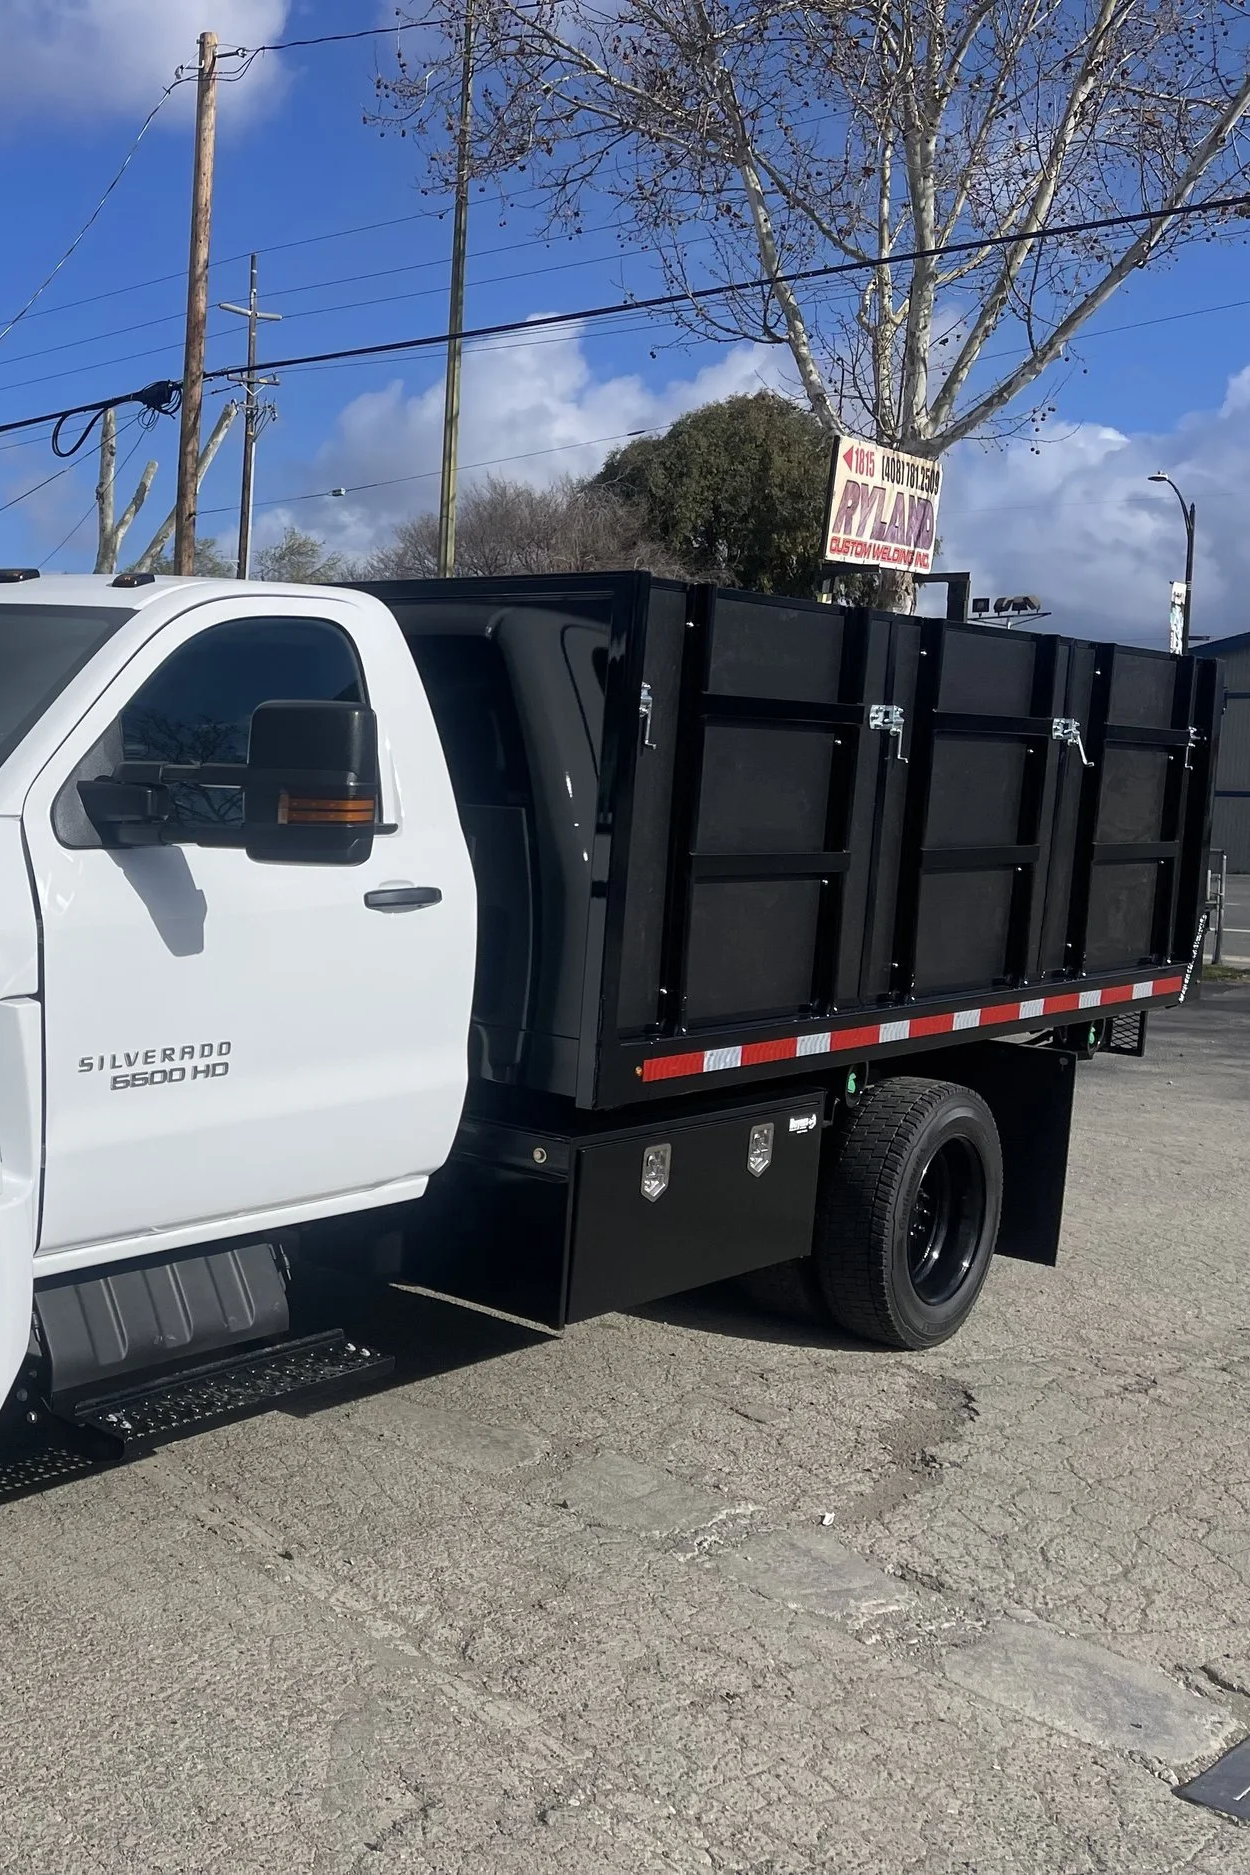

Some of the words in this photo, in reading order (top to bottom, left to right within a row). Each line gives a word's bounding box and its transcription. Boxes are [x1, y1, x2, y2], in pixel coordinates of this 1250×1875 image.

[855, 448, 875, 478] 1815
[881, 455, 904, 486] (408)
[832, 480, 934, 550] RYLAND
[830, 536, 871, 560] CUSTOM
[872, 543, 914, 566] WELDING
[78, 1041, 232, 1073] SILVERADO
[191, 1061, 229, 1081] HD
